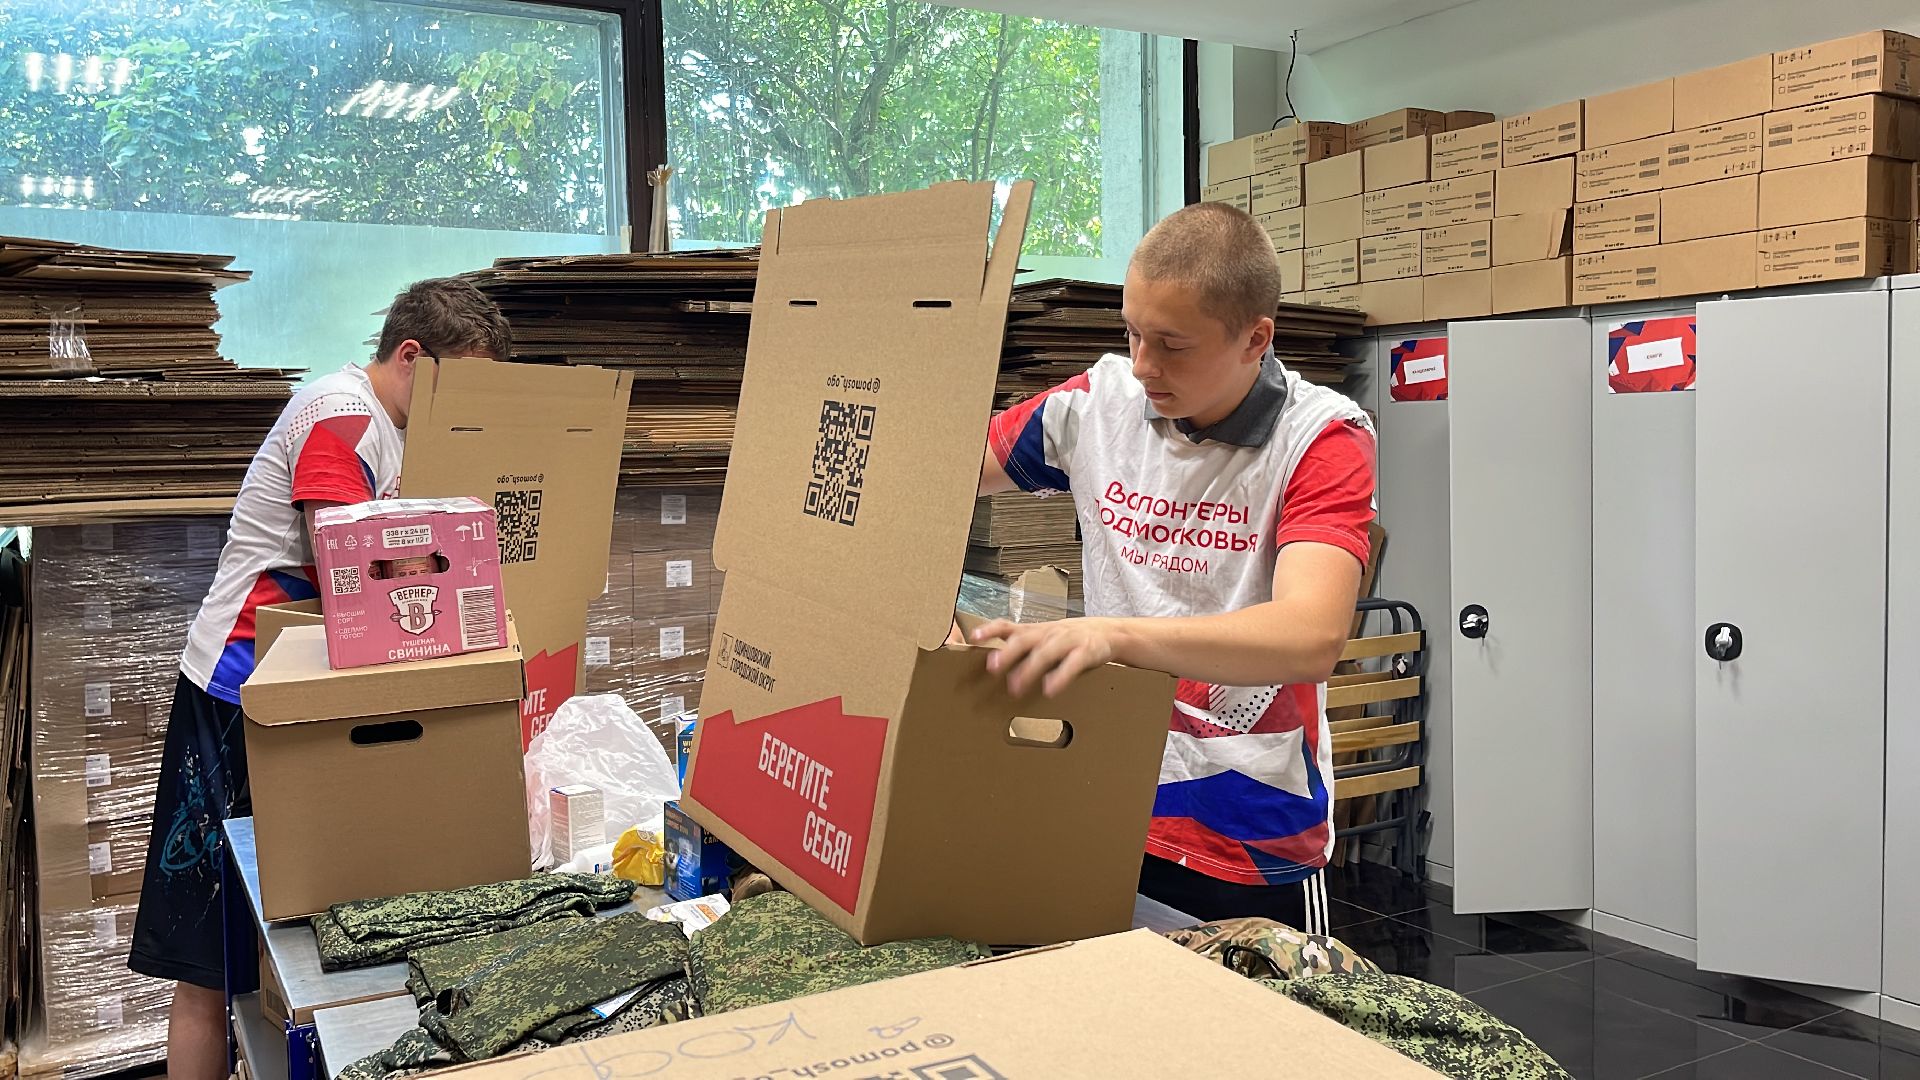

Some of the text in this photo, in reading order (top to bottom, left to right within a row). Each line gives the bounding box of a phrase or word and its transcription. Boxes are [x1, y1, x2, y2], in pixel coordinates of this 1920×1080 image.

[826, 374, 881, 393] @pomosh_ogo
[497, 473, 544, 485] @pomosh_ogo
[385, 529, 399, 537] 338
[1095, 497, 1259, 553] ОДМОСКОВЬЯ
[1120, 546, 1209, 575] МЫ РЯДОМ
[396, 588, 432, 601] ВЕРНЕР
[388, 643, 451, 661] СВИНИНА
[402, 637, 436, 647] ТУШЕНАЯ
[734, 638, 772, 670] ОДИНЦОВСКИЙ
[758, 671, 777, 694] ОКРУГ
[757, 731, 834, 811] БЕРЕГИТЕ
[802, 810, 852, 878] СЕБЯ!
